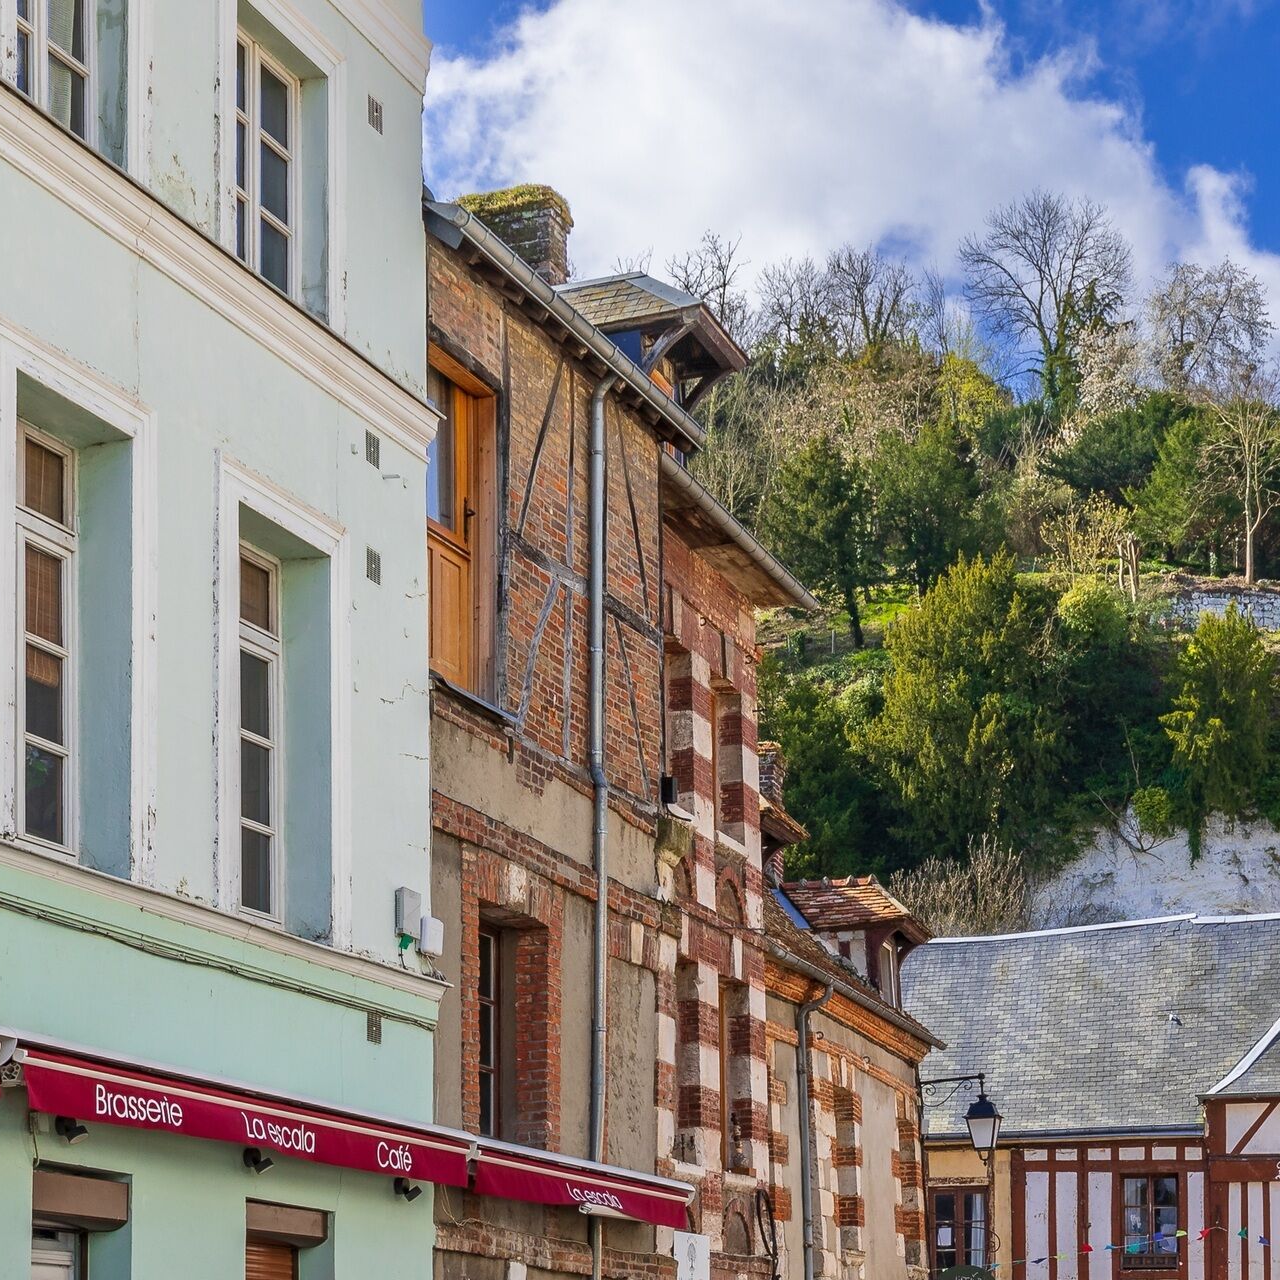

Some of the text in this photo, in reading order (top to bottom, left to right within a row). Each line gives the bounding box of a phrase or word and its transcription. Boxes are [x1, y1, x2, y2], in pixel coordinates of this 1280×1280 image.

[95, 1084, 184, 1127] Brasserie
[241, 1110, 316, 1154] La escala
[376, 1141, 413, 1172] Café
